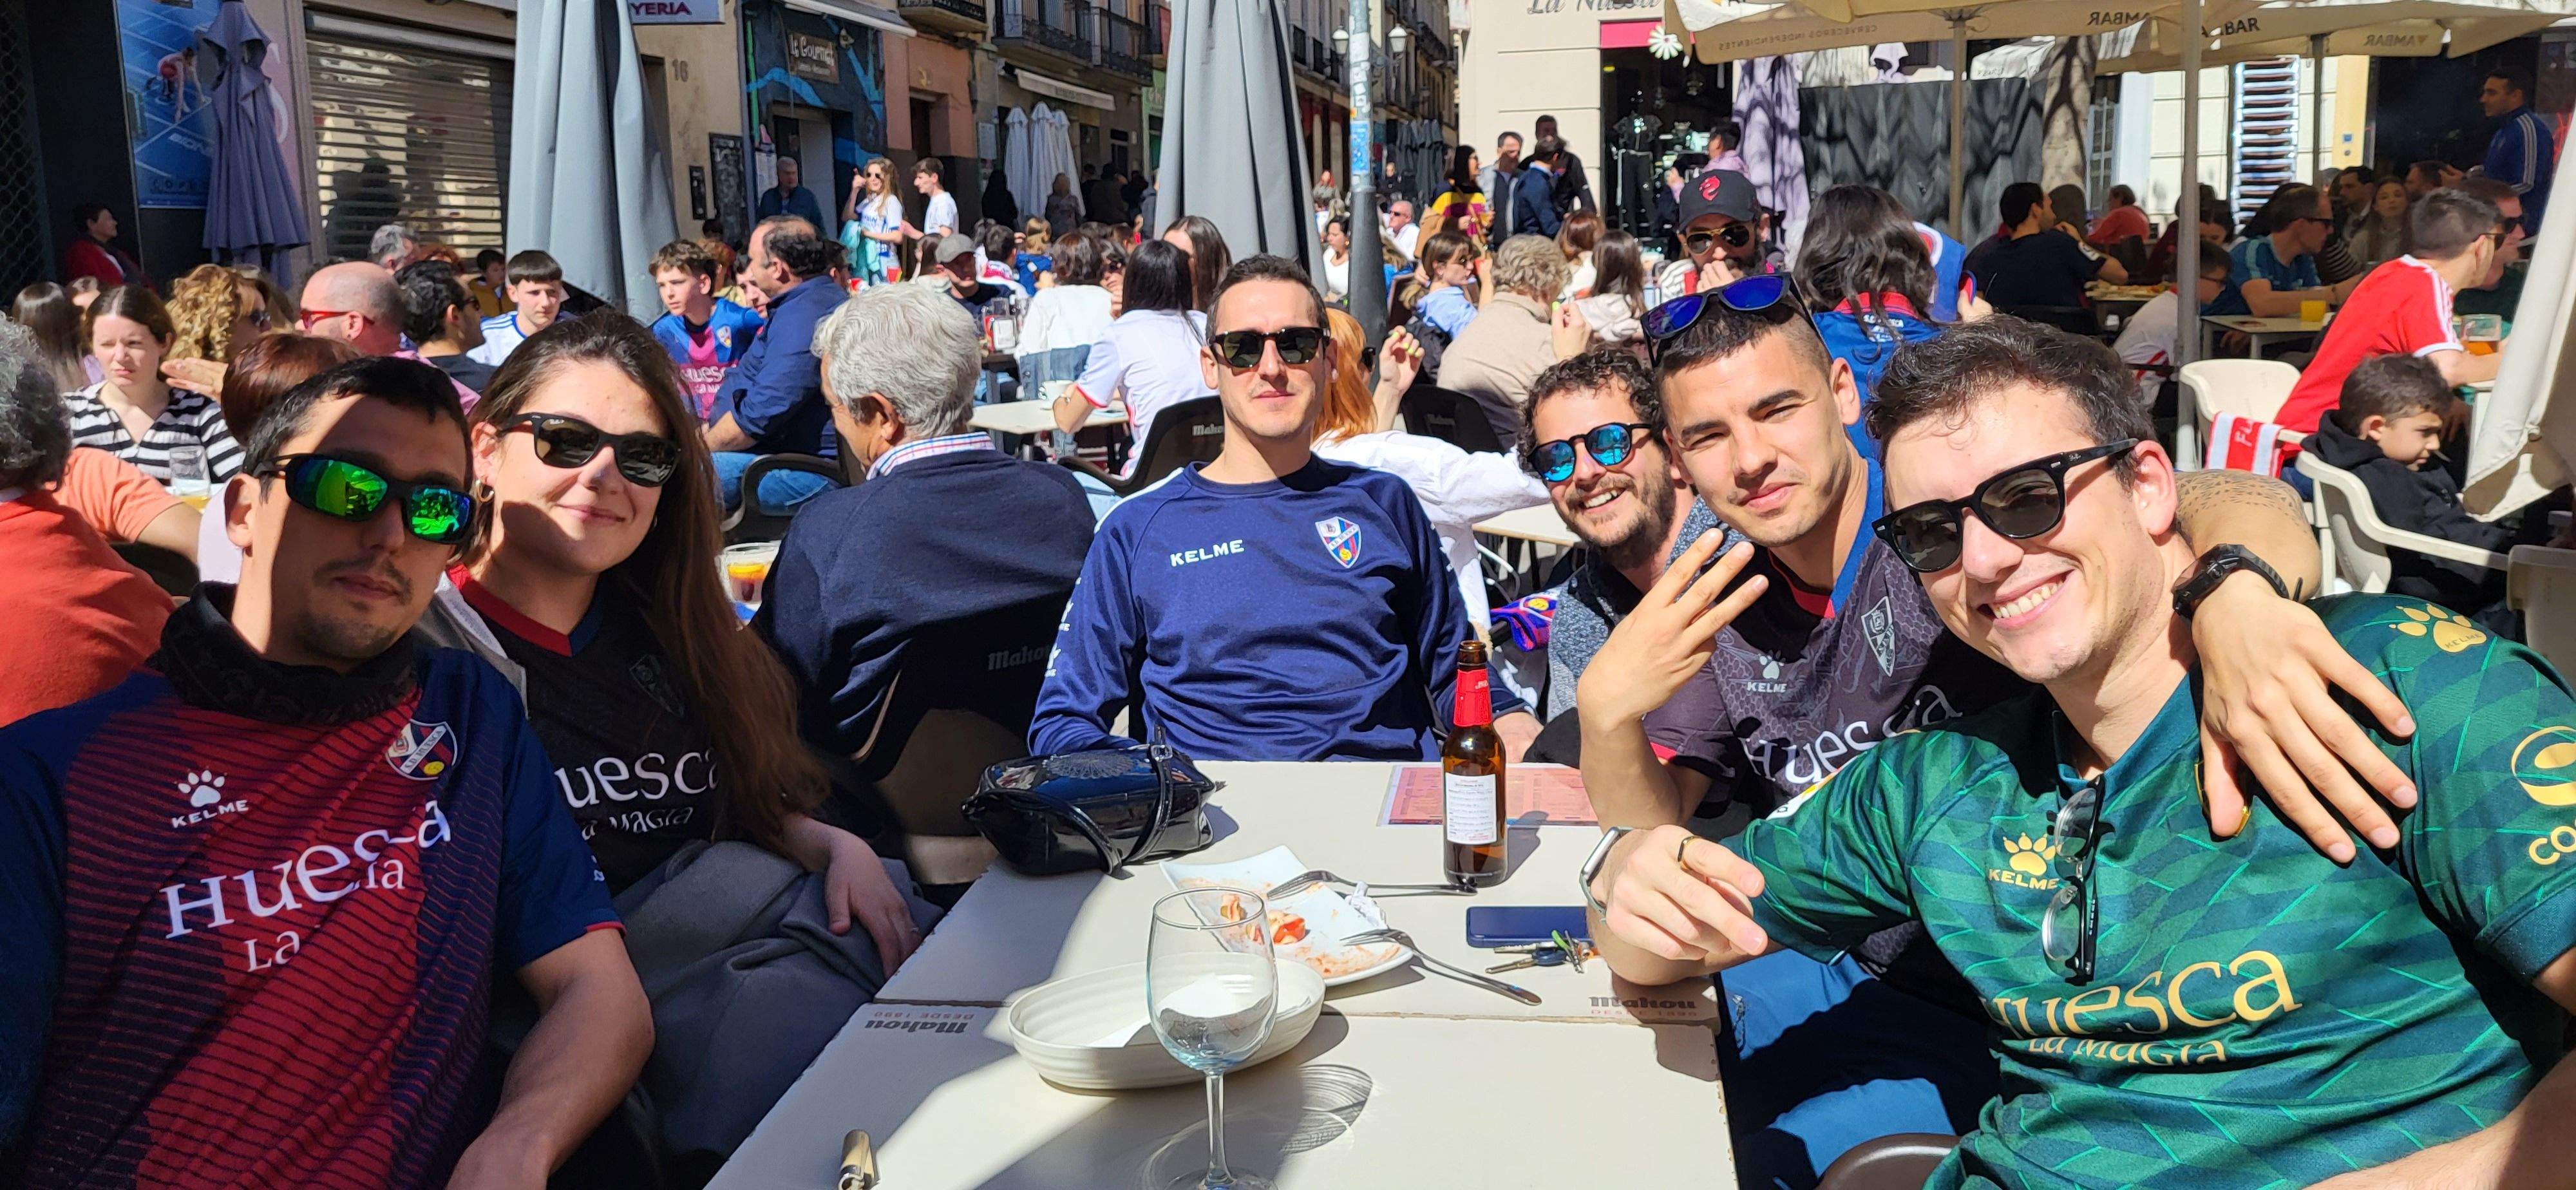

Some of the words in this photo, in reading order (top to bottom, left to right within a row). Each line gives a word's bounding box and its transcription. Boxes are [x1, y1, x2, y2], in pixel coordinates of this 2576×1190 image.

[1170, 539, 1245, 567] KELME
[171, 800, 249, 828] KELME
[1988, 869, 2061, 890] KELME
[243, 930, 300, 972] La
[1589, 996, 1696, 1008] Mahou
[864, 1020, 968, 1034] Mahou
